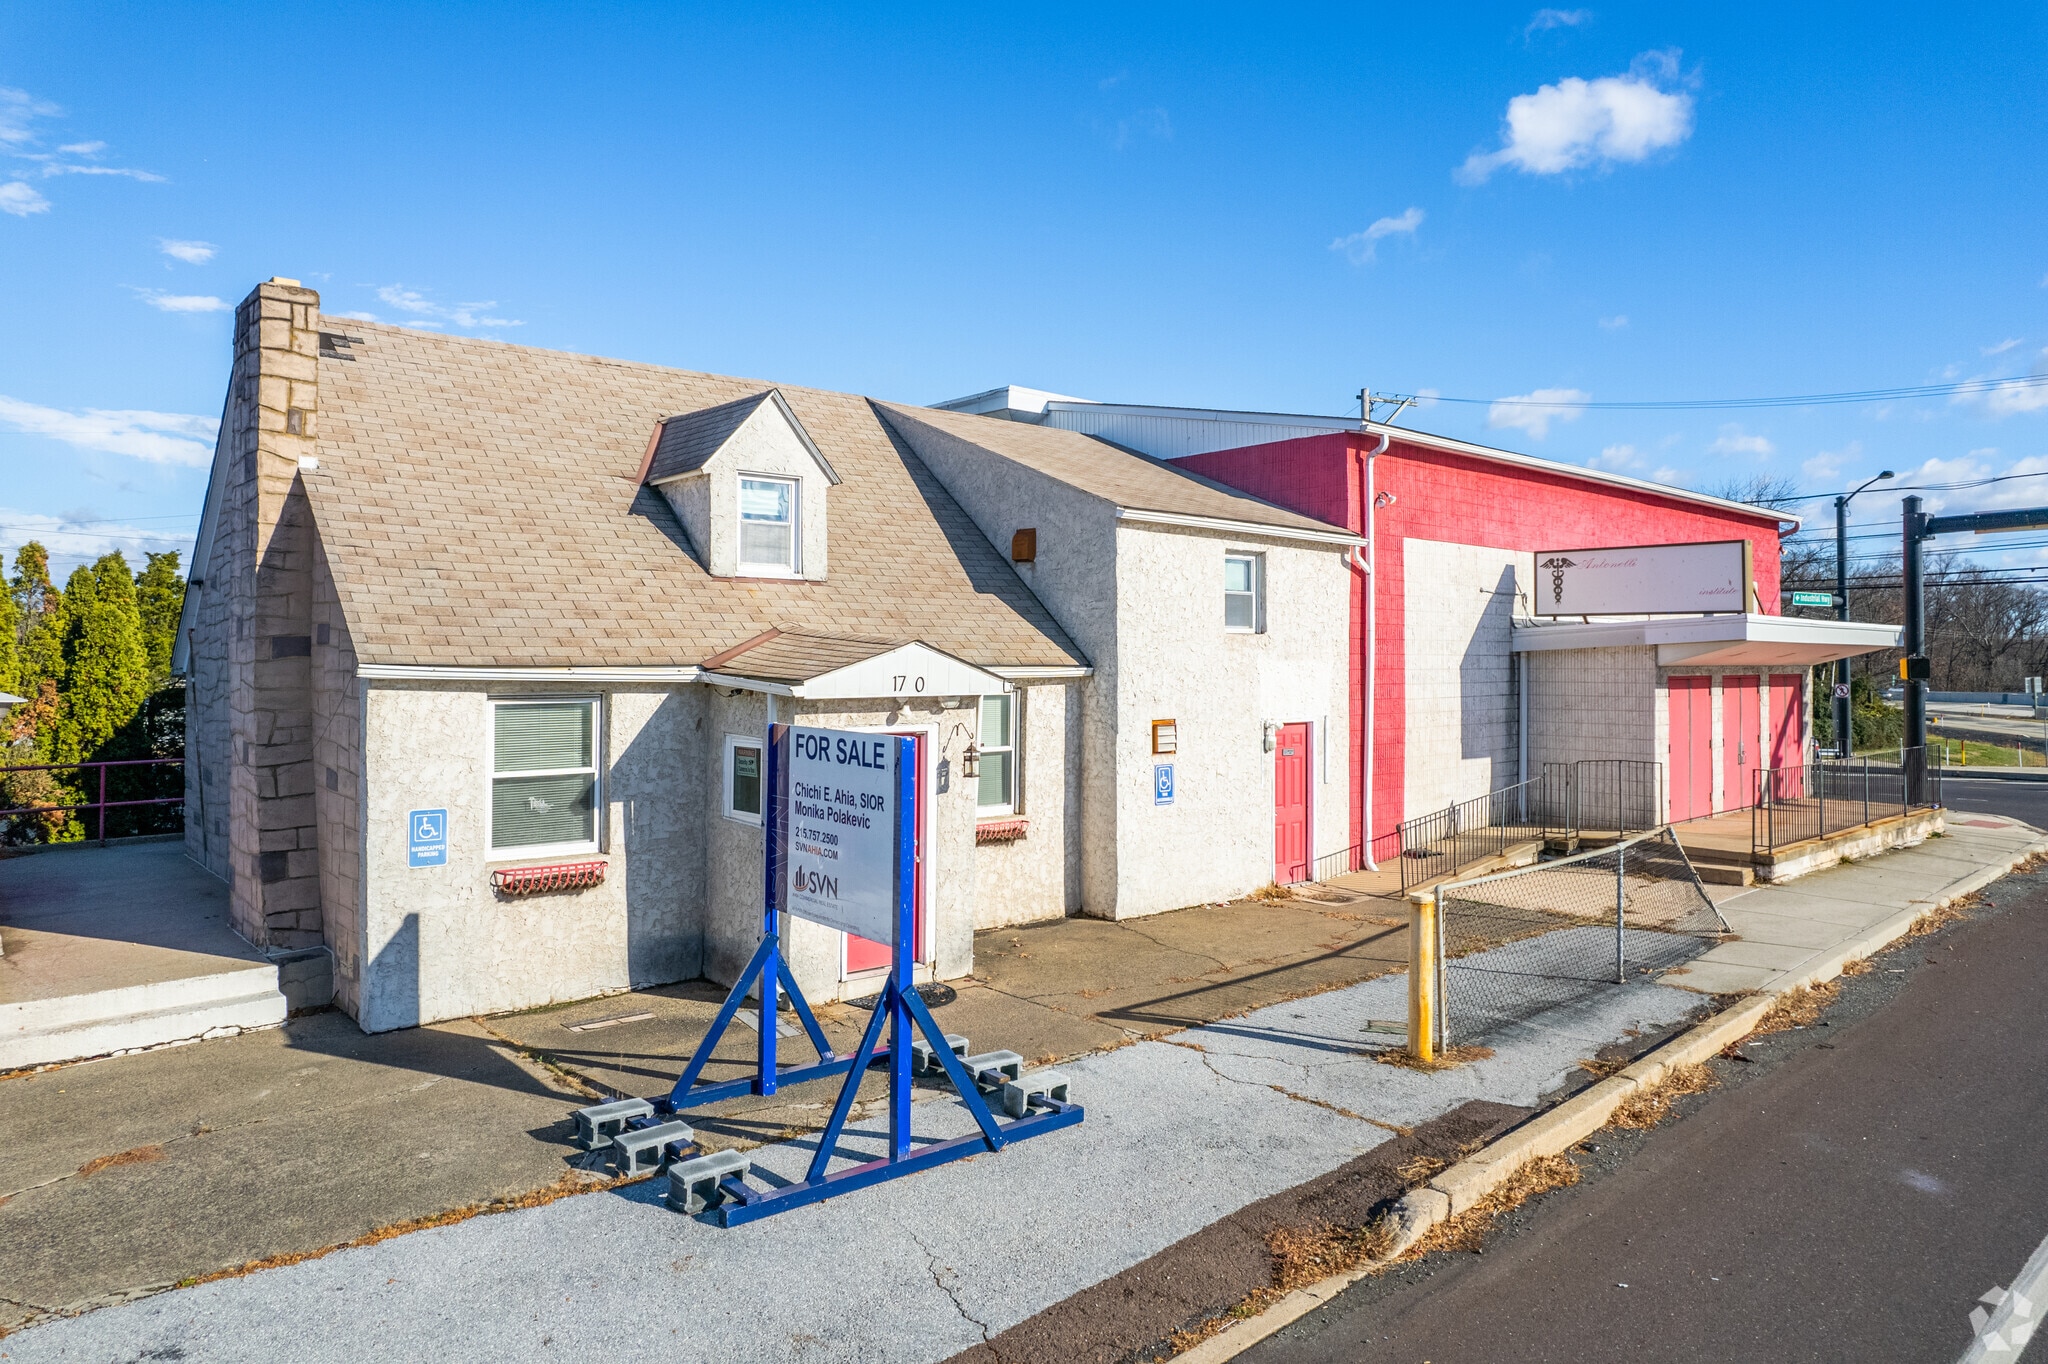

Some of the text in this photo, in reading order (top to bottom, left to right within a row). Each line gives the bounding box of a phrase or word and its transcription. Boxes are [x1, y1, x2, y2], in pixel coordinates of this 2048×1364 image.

[795, 733, 885, 770] FOR SALE
[795, 782, 885, 812] Chichi E. Ahia, SIOR
[795, 800, 871, 830] Monika Polakevic
[795, 826, 839, 846] 215.757.2500
[795, 841, 839, 860] SVNAHIA.COM
[809, 871, 838, 900] SVN
